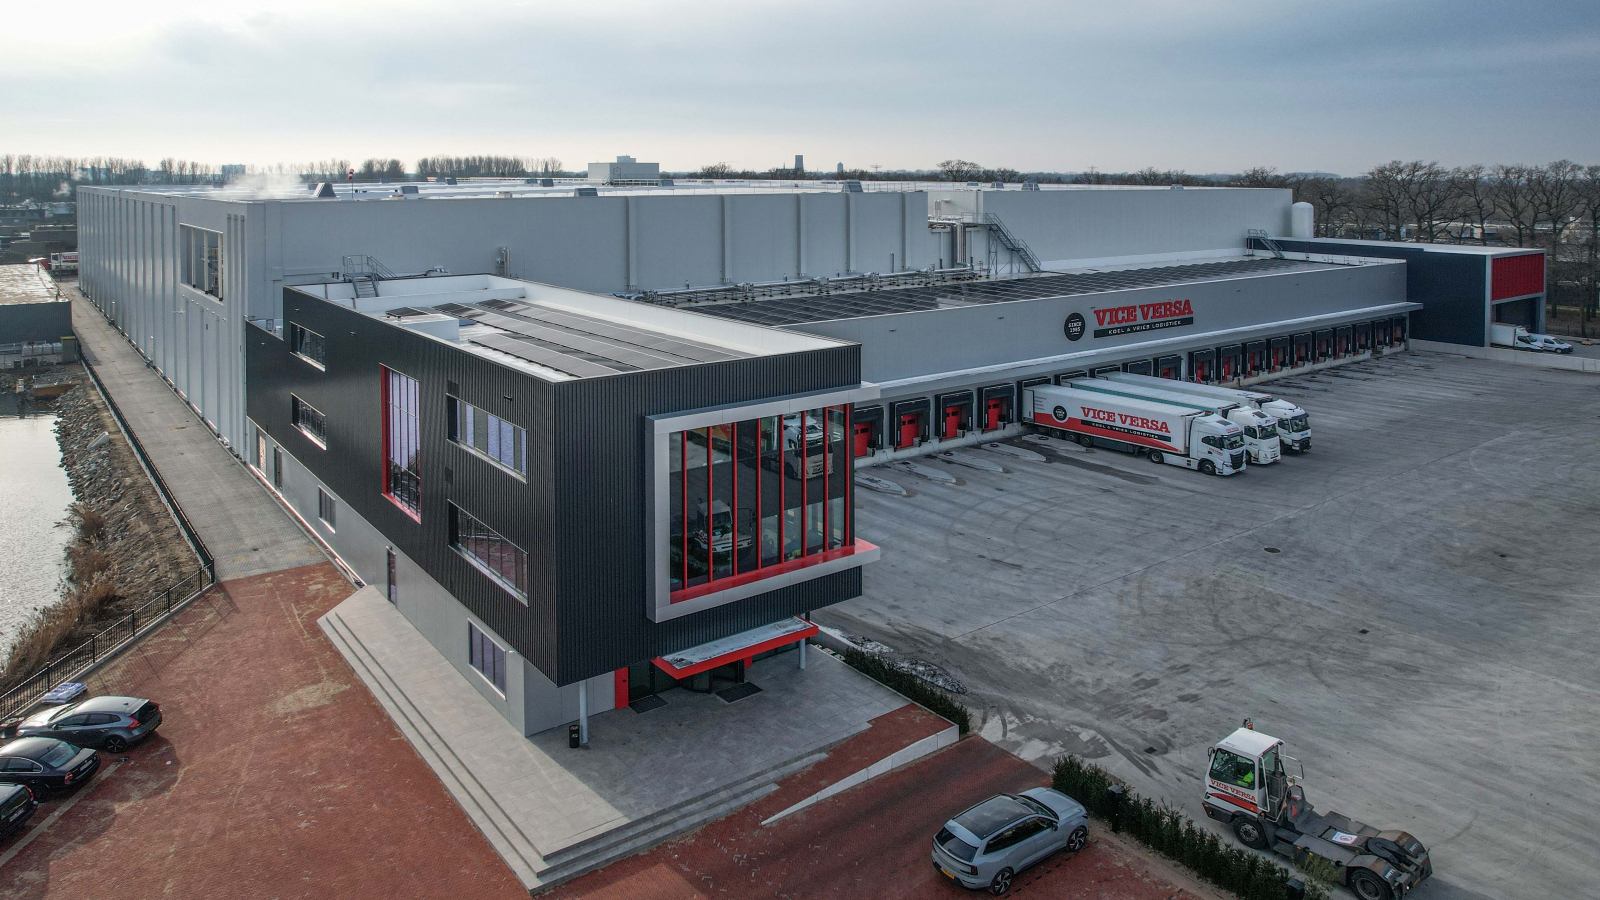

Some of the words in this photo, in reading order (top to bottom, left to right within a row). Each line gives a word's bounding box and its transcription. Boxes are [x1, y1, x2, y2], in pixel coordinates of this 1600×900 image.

[1094, 305, 1137, 326] VICE
[1139, 299, 1193, 320] VERSA
[1152, 320, 1182, 329] LOGISTIEK
[1080, 406, 1116, 423] VICE
[1118, 413, 1171, 434] VERSA
[1210, 779, 1229, 791] VICE
[1230, 787, 1257, 802] VERSA
